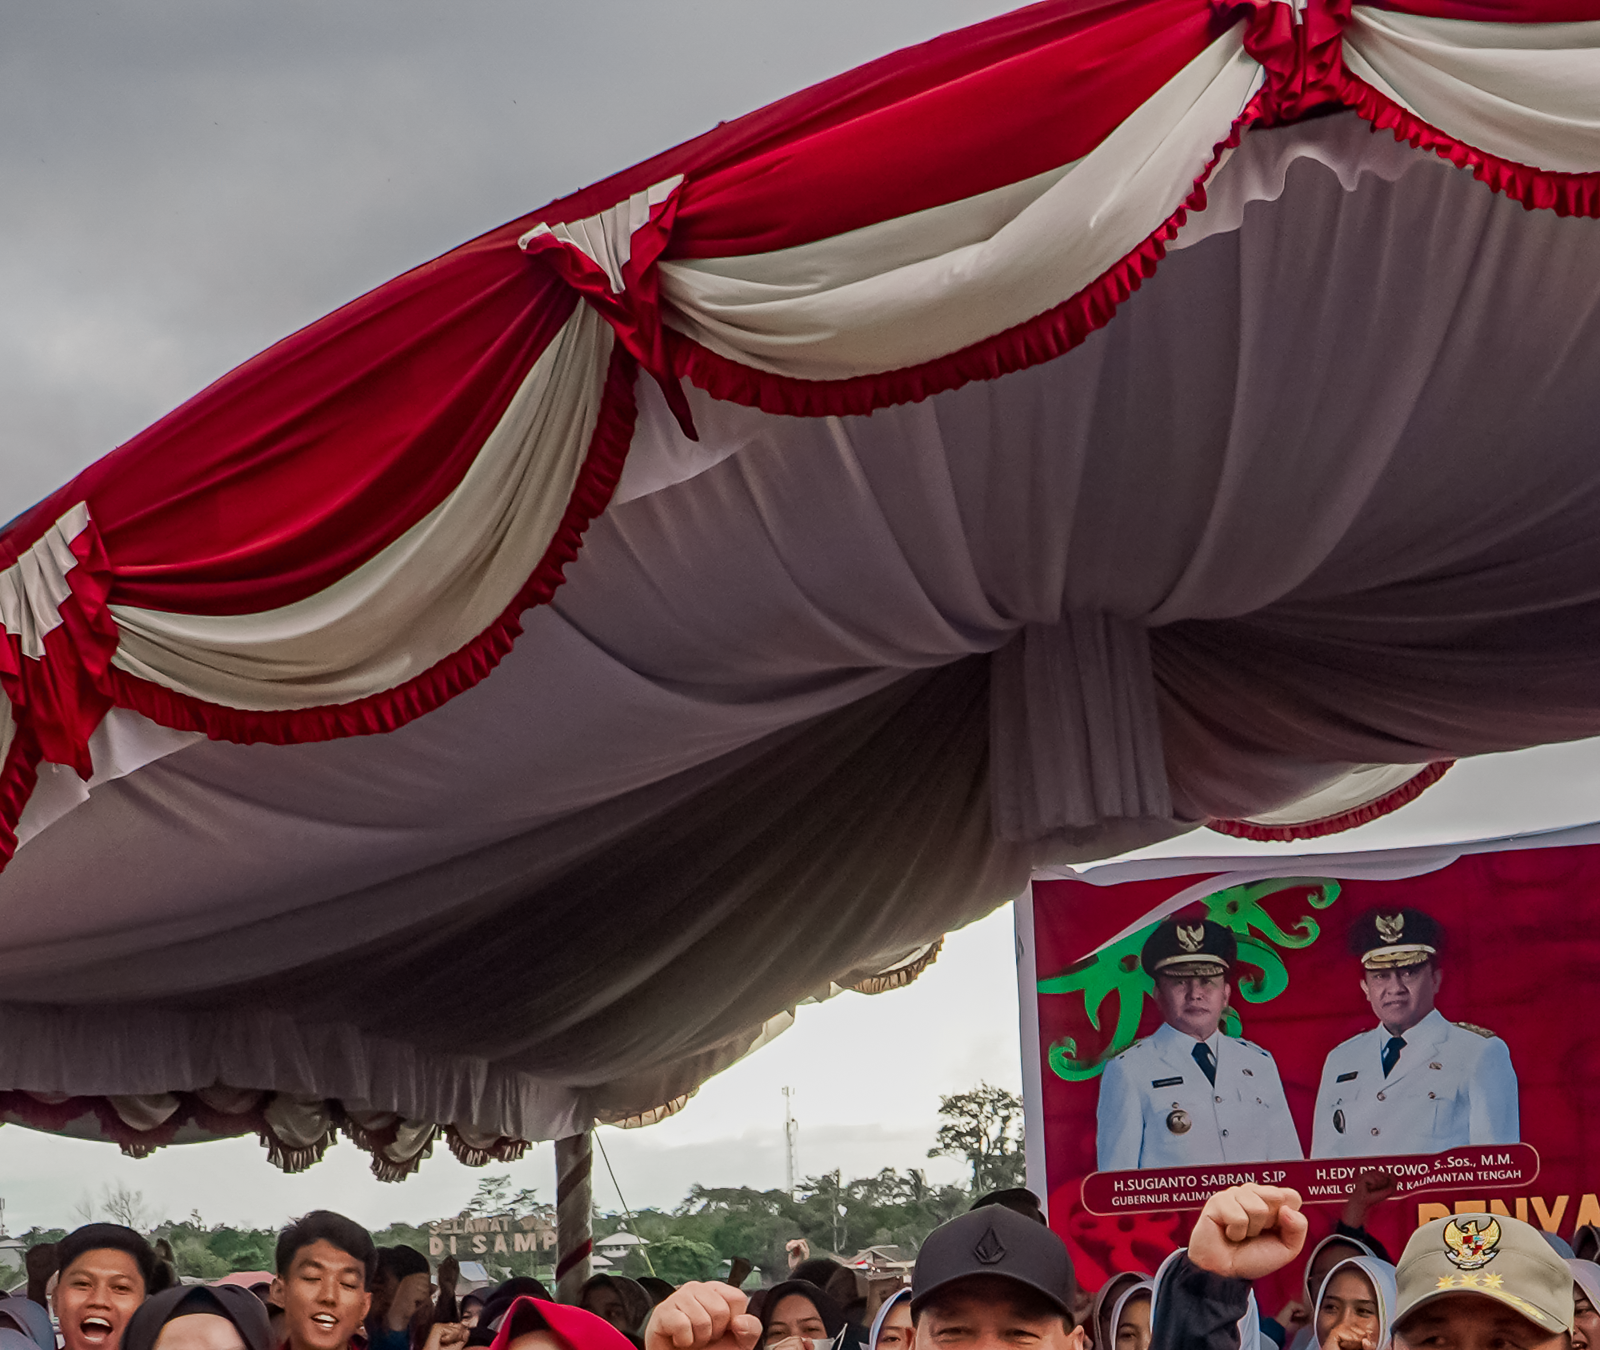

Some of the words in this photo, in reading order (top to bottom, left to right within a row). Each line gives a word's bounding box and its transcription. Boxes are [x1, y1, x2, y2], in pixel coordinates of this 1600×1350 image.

[1316, 1167, 1355, 1180] H.EDY
[1481, 1153, 1514, 1166] M.M.
[1114, 1176, 1197, 1192] H.SUGIANTO
[1201, 1172, 1258, 1187] SABRAN,
[1262, 1171, 1286, 1184] S.IP
[1308, 1185, 1342, 1195] WAKIL
[1406, 1172, 1473, 1190] KALIMANTAN
[1477, 1170, 1521, 1182] TENGAH
[1112, 1193, 1170, 1206] GUBERNUR
[429, 1216, 509, 1235] SELAMAT
